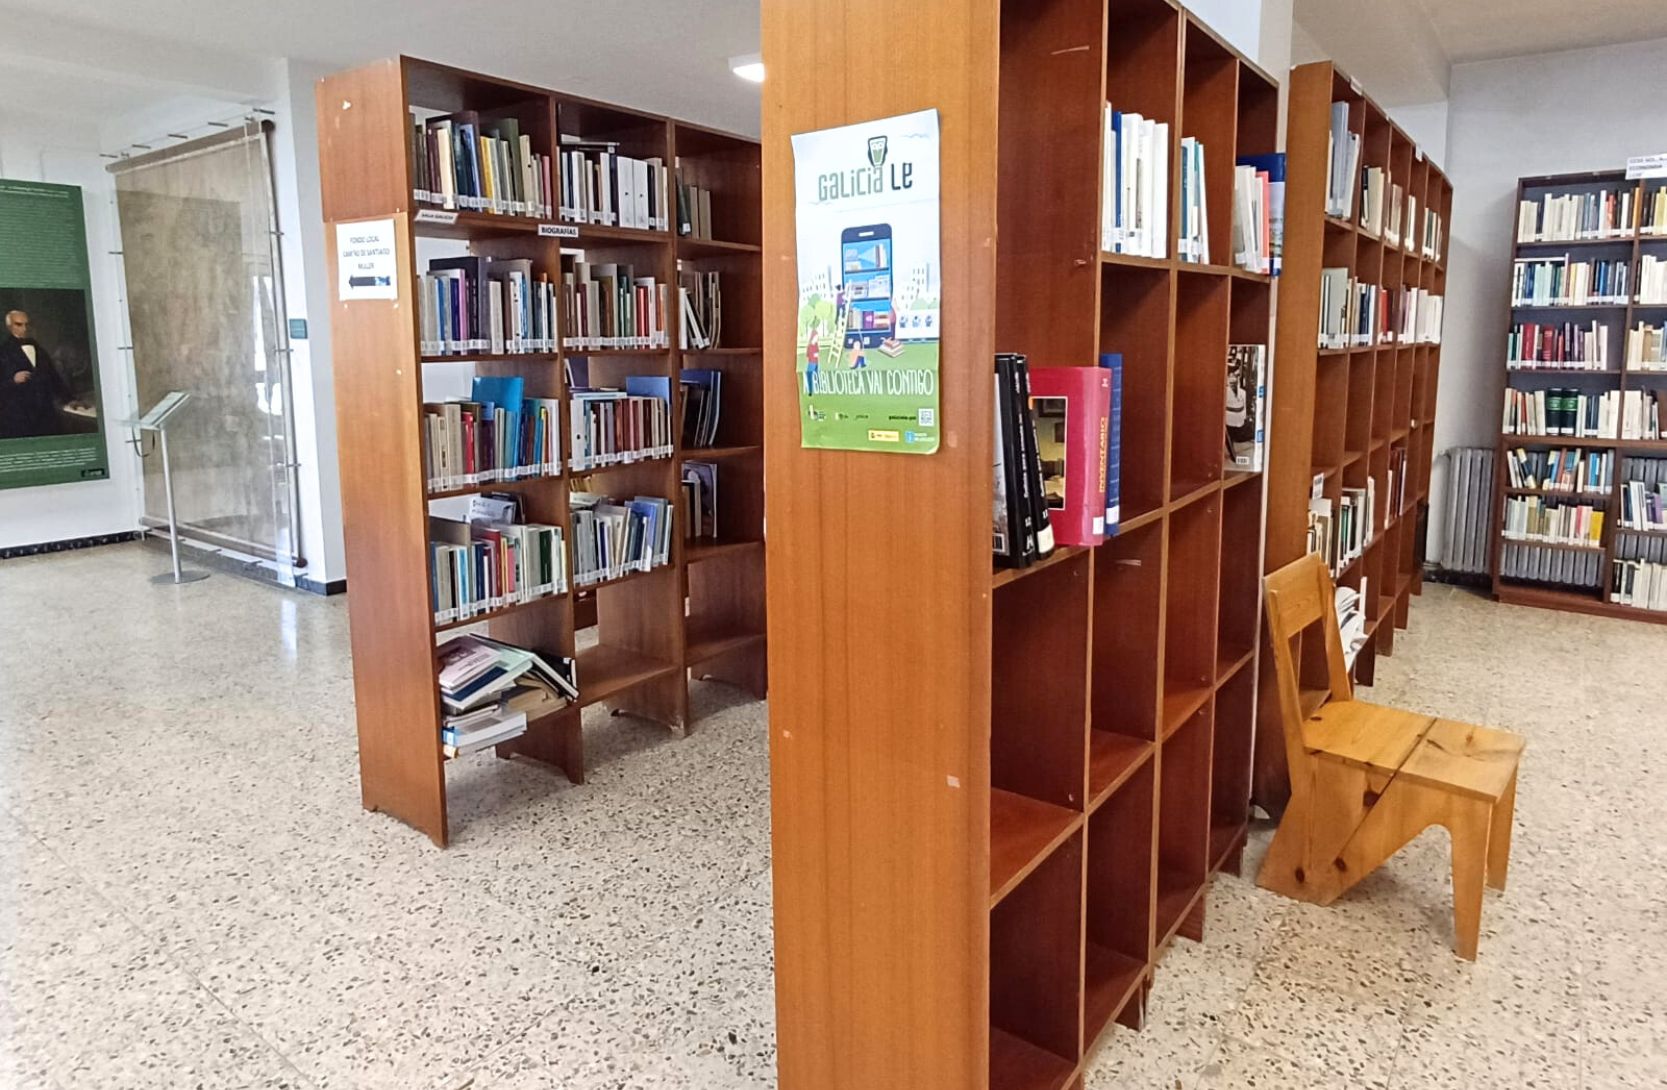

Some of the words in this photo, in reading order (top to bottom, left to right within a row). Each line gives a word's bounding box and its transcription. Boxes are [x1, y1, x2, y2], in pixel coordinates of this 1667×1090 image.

[812, 370, 866, 396] BIBLIOTECA
[866, 371, 883, 395] VAI
[887, 369, 935, 396] CONTIGO
